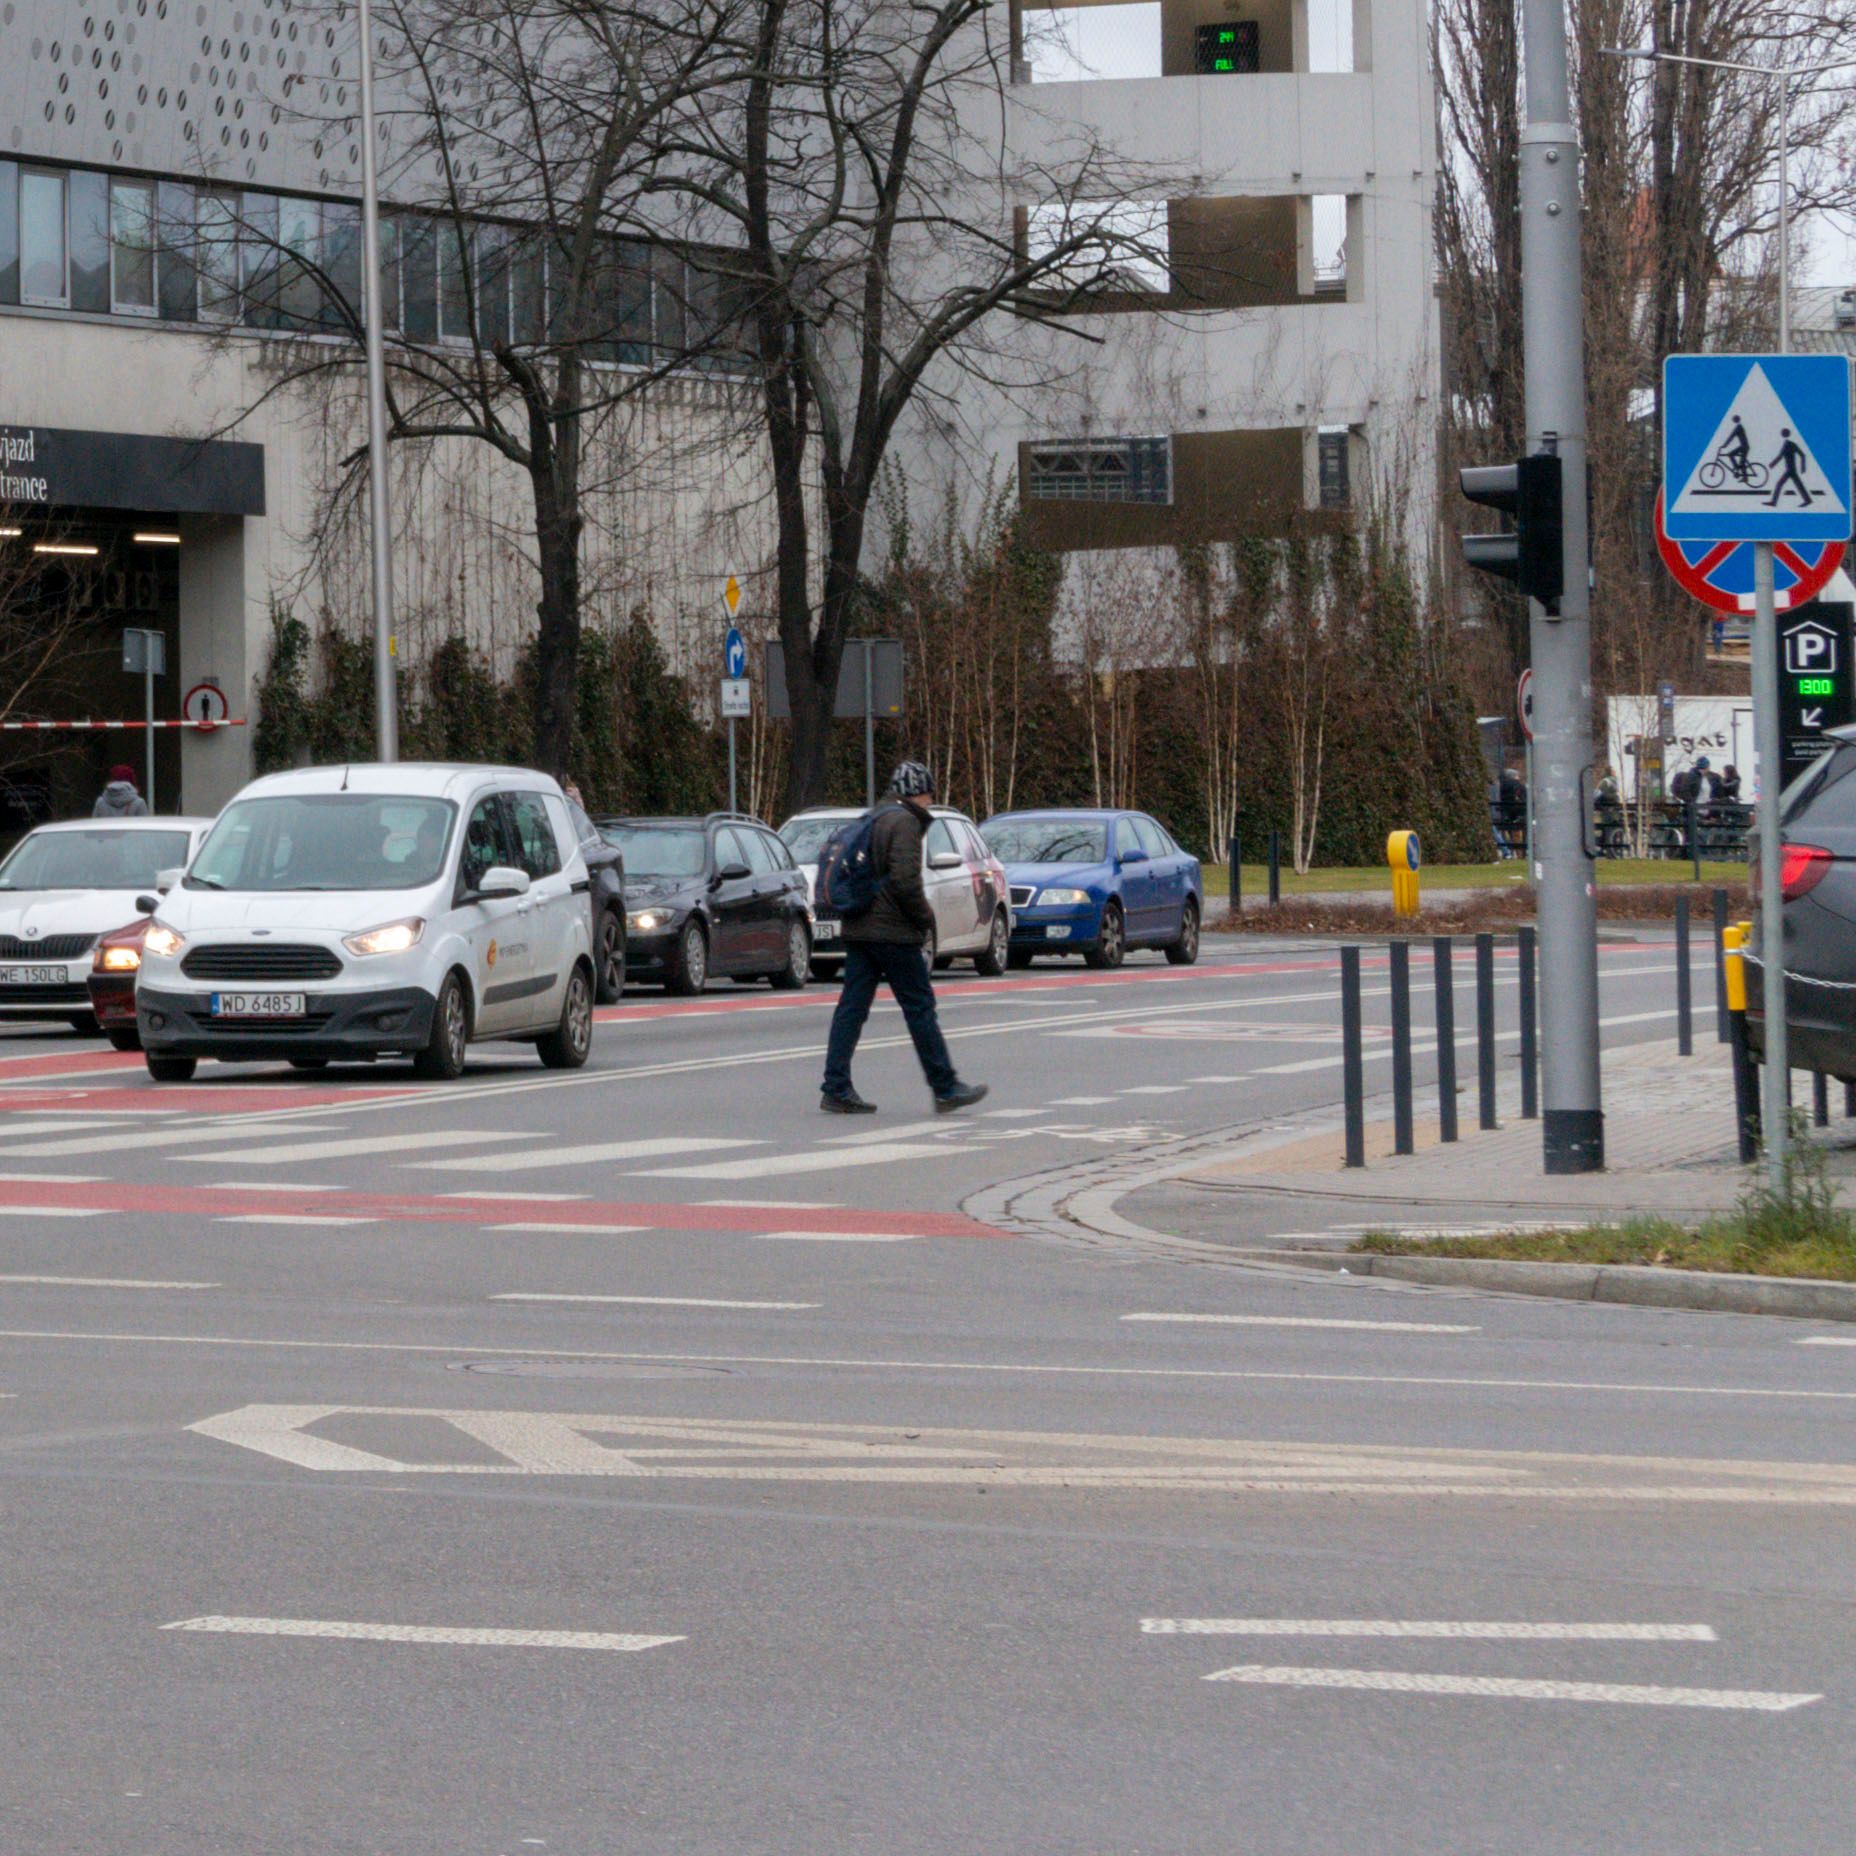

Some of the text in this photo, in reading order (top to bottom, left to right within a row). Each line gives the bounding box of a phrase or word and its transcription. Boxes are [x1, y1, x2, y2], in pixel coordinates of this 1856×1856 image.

[1799, 679, 1832, 695] 1300
[0, 968, 19, 982] WE
[221, 995, 302, 1012] WD 6485J
